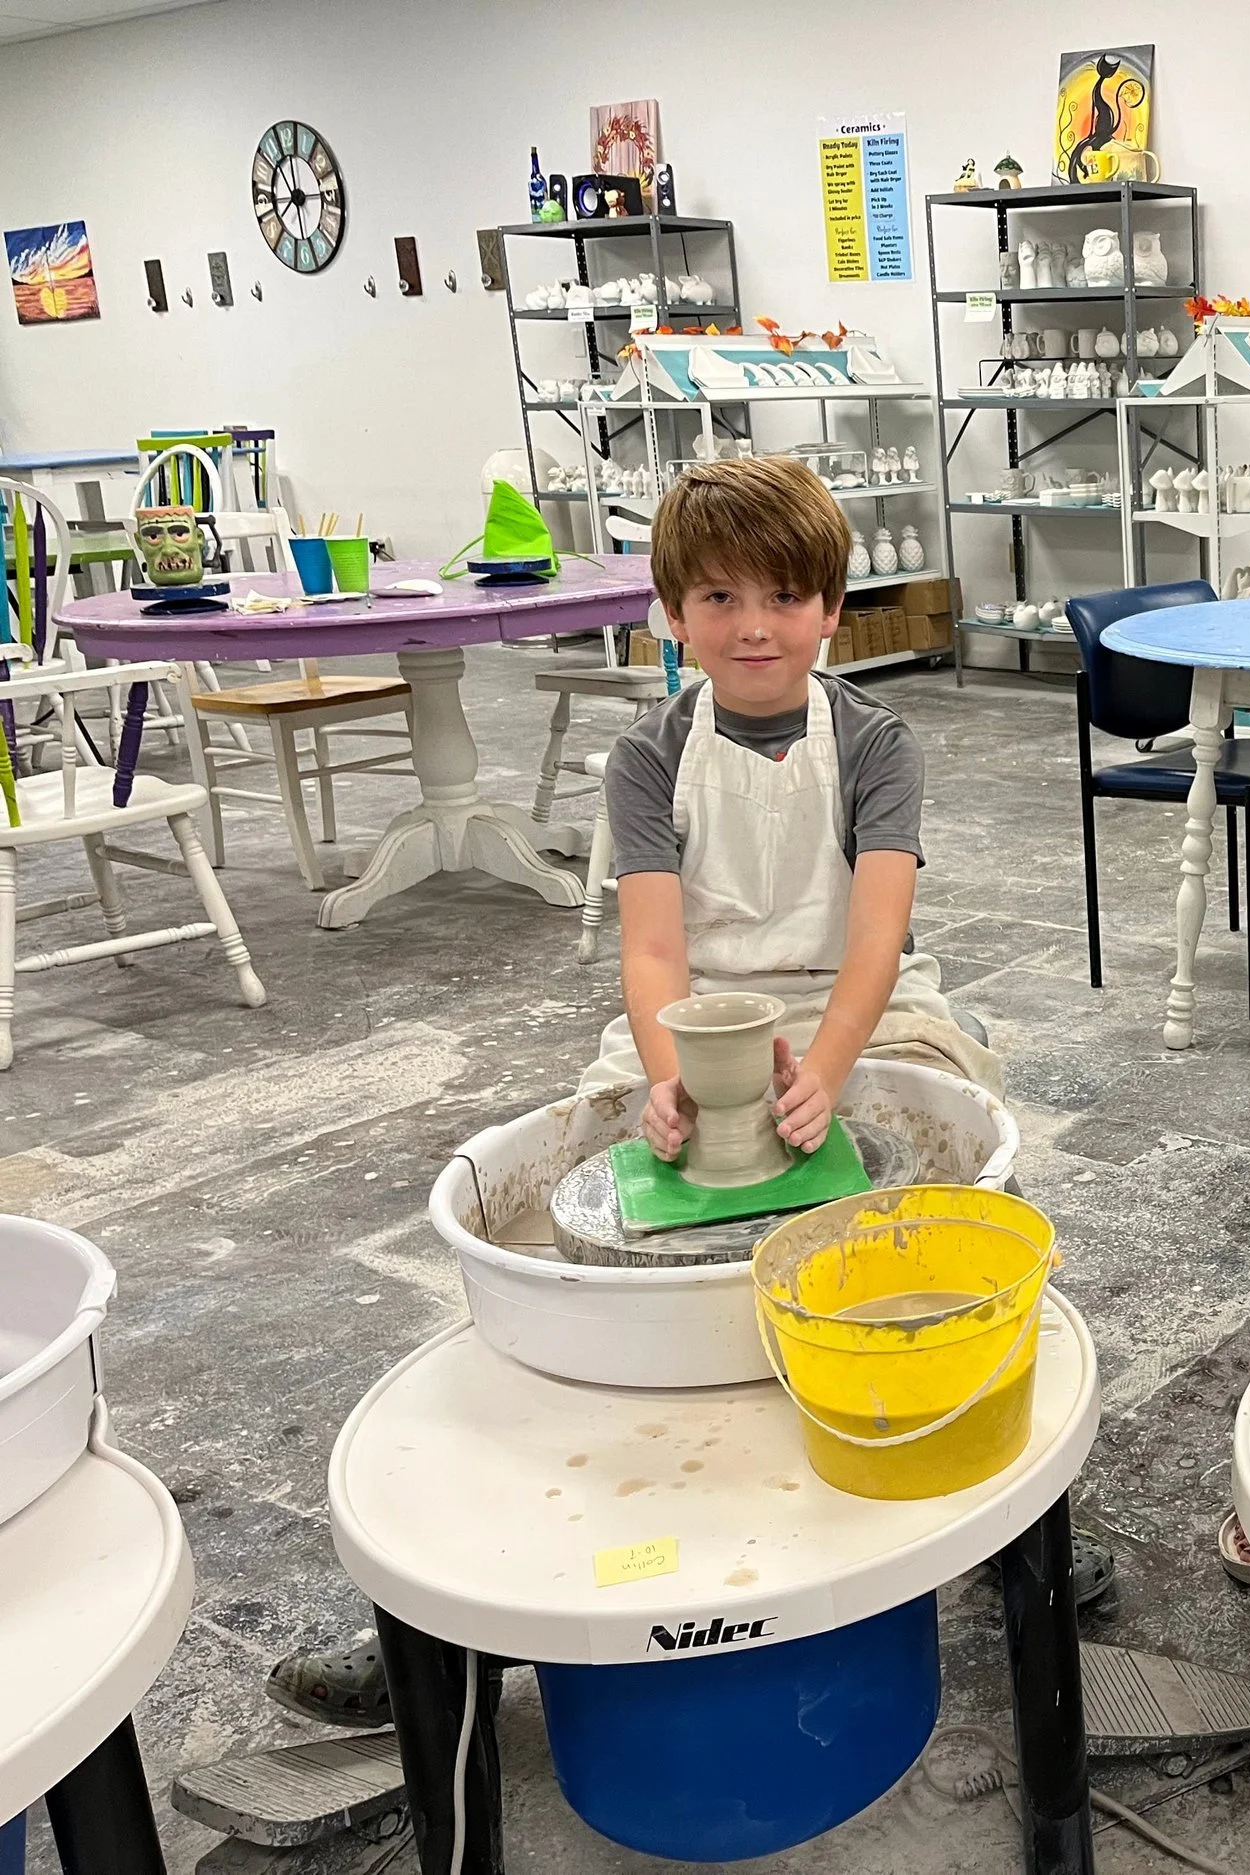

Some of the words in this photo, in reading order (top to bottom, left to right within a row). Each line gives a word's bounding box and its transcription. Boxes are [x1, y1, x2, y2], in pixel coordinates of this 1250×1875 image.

[841, 123, 880, 133] Ceramics
[280, 128, 292, 148] 12
[867, 138, 879, 146] Kiln
[881, 137, 899, 146] Firing
[316, 155, 325, 172] 2
[301, 246, 309, 264] 6
[622, 1556, 664, 1570] Collin
[647, 1617, 778, 1652] Nidec
